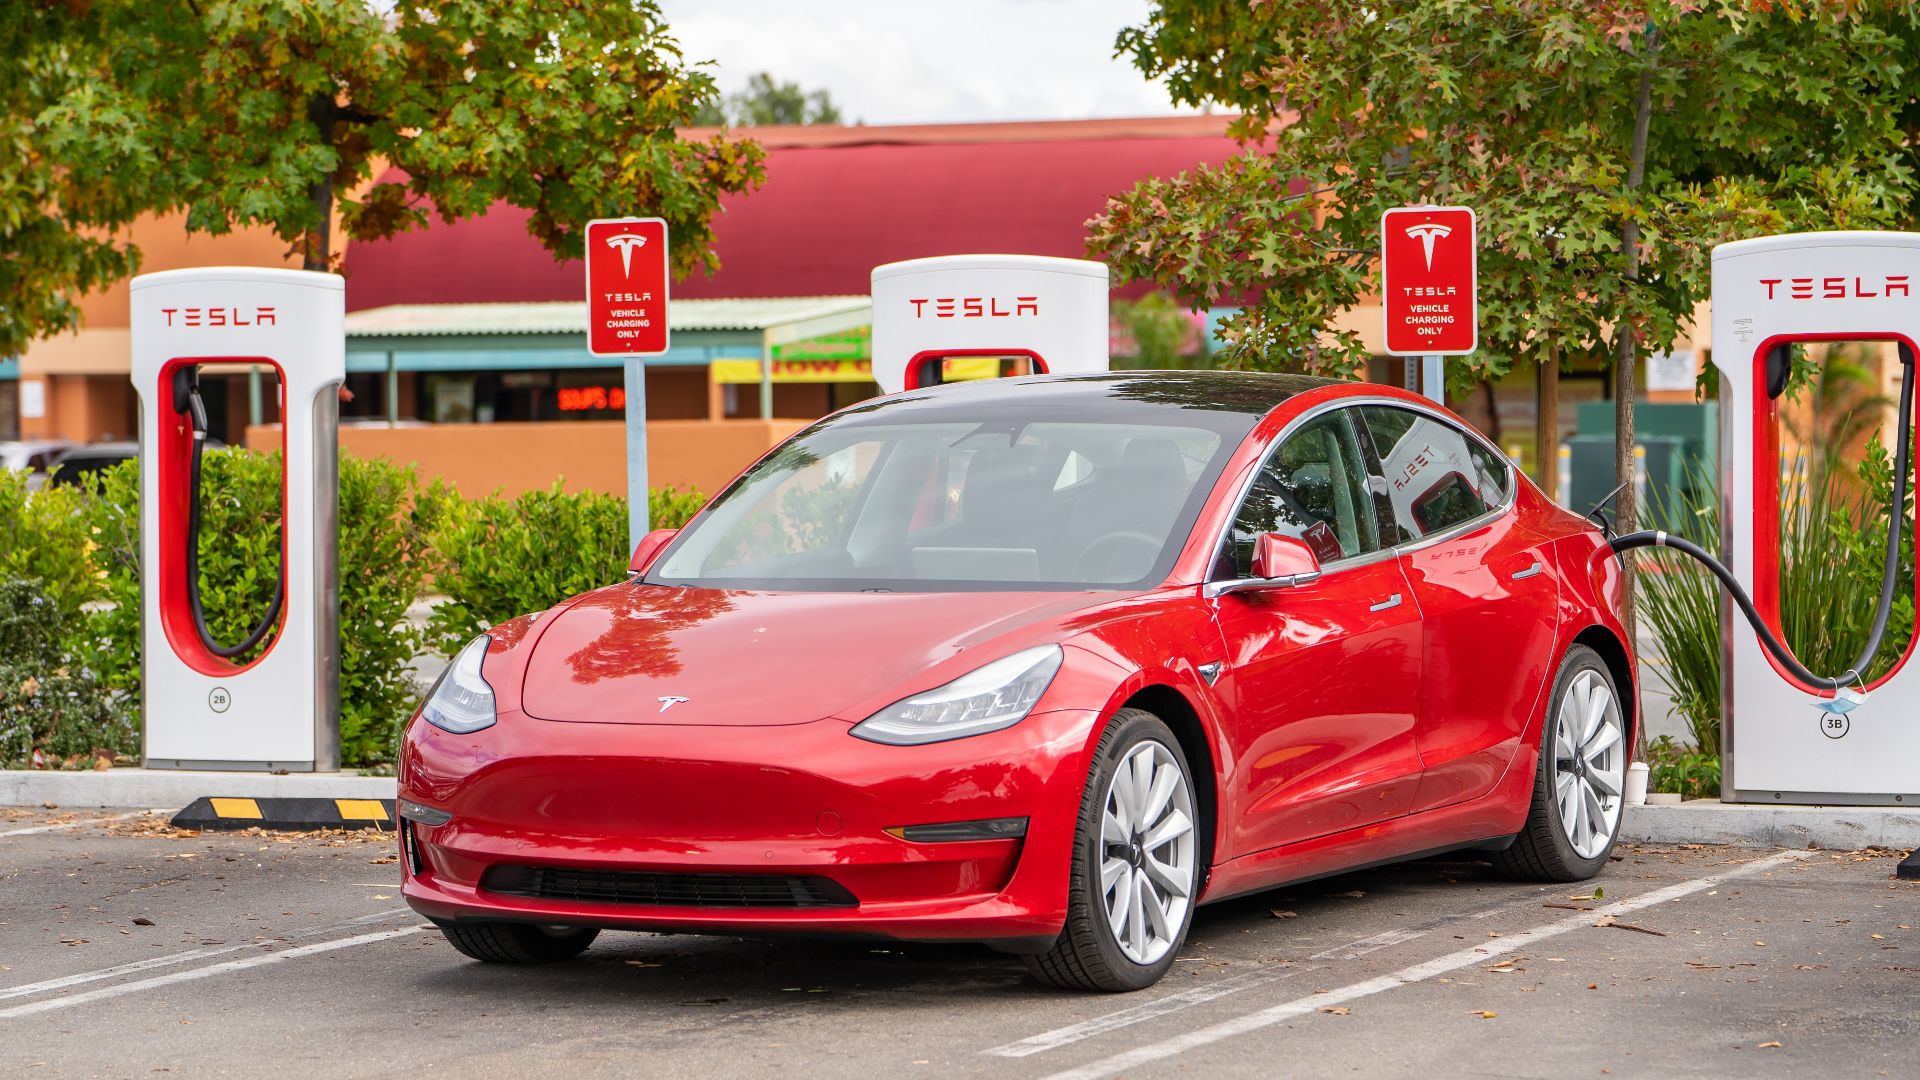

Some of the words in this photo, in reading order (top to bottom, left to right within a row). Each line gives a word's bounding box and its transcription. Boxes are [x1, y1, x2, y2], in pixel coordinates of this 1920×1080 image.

[1404, 286, 1456, 297] TESLA
[1759, 276, 1909, 300] TESLA
[605, 292, 651, 302] TESLA
[909, 297, 1038, 319] TESLA
[1410, 304, 1449, 313] VEHICLE
[161, 307, 276, 327] TESLA
[611, 309, 645, 318] VEHICLE
[606, 319, 650, 328] CHARGING
[1405, 315, 1455, 325] CHARGING
[616, 330, 640, 339] ONLY
[1417, 326, 1443, 336] ONLY
[214, 696, 226, 704] 2B
[1827, 719, 1843, 728] 3B
